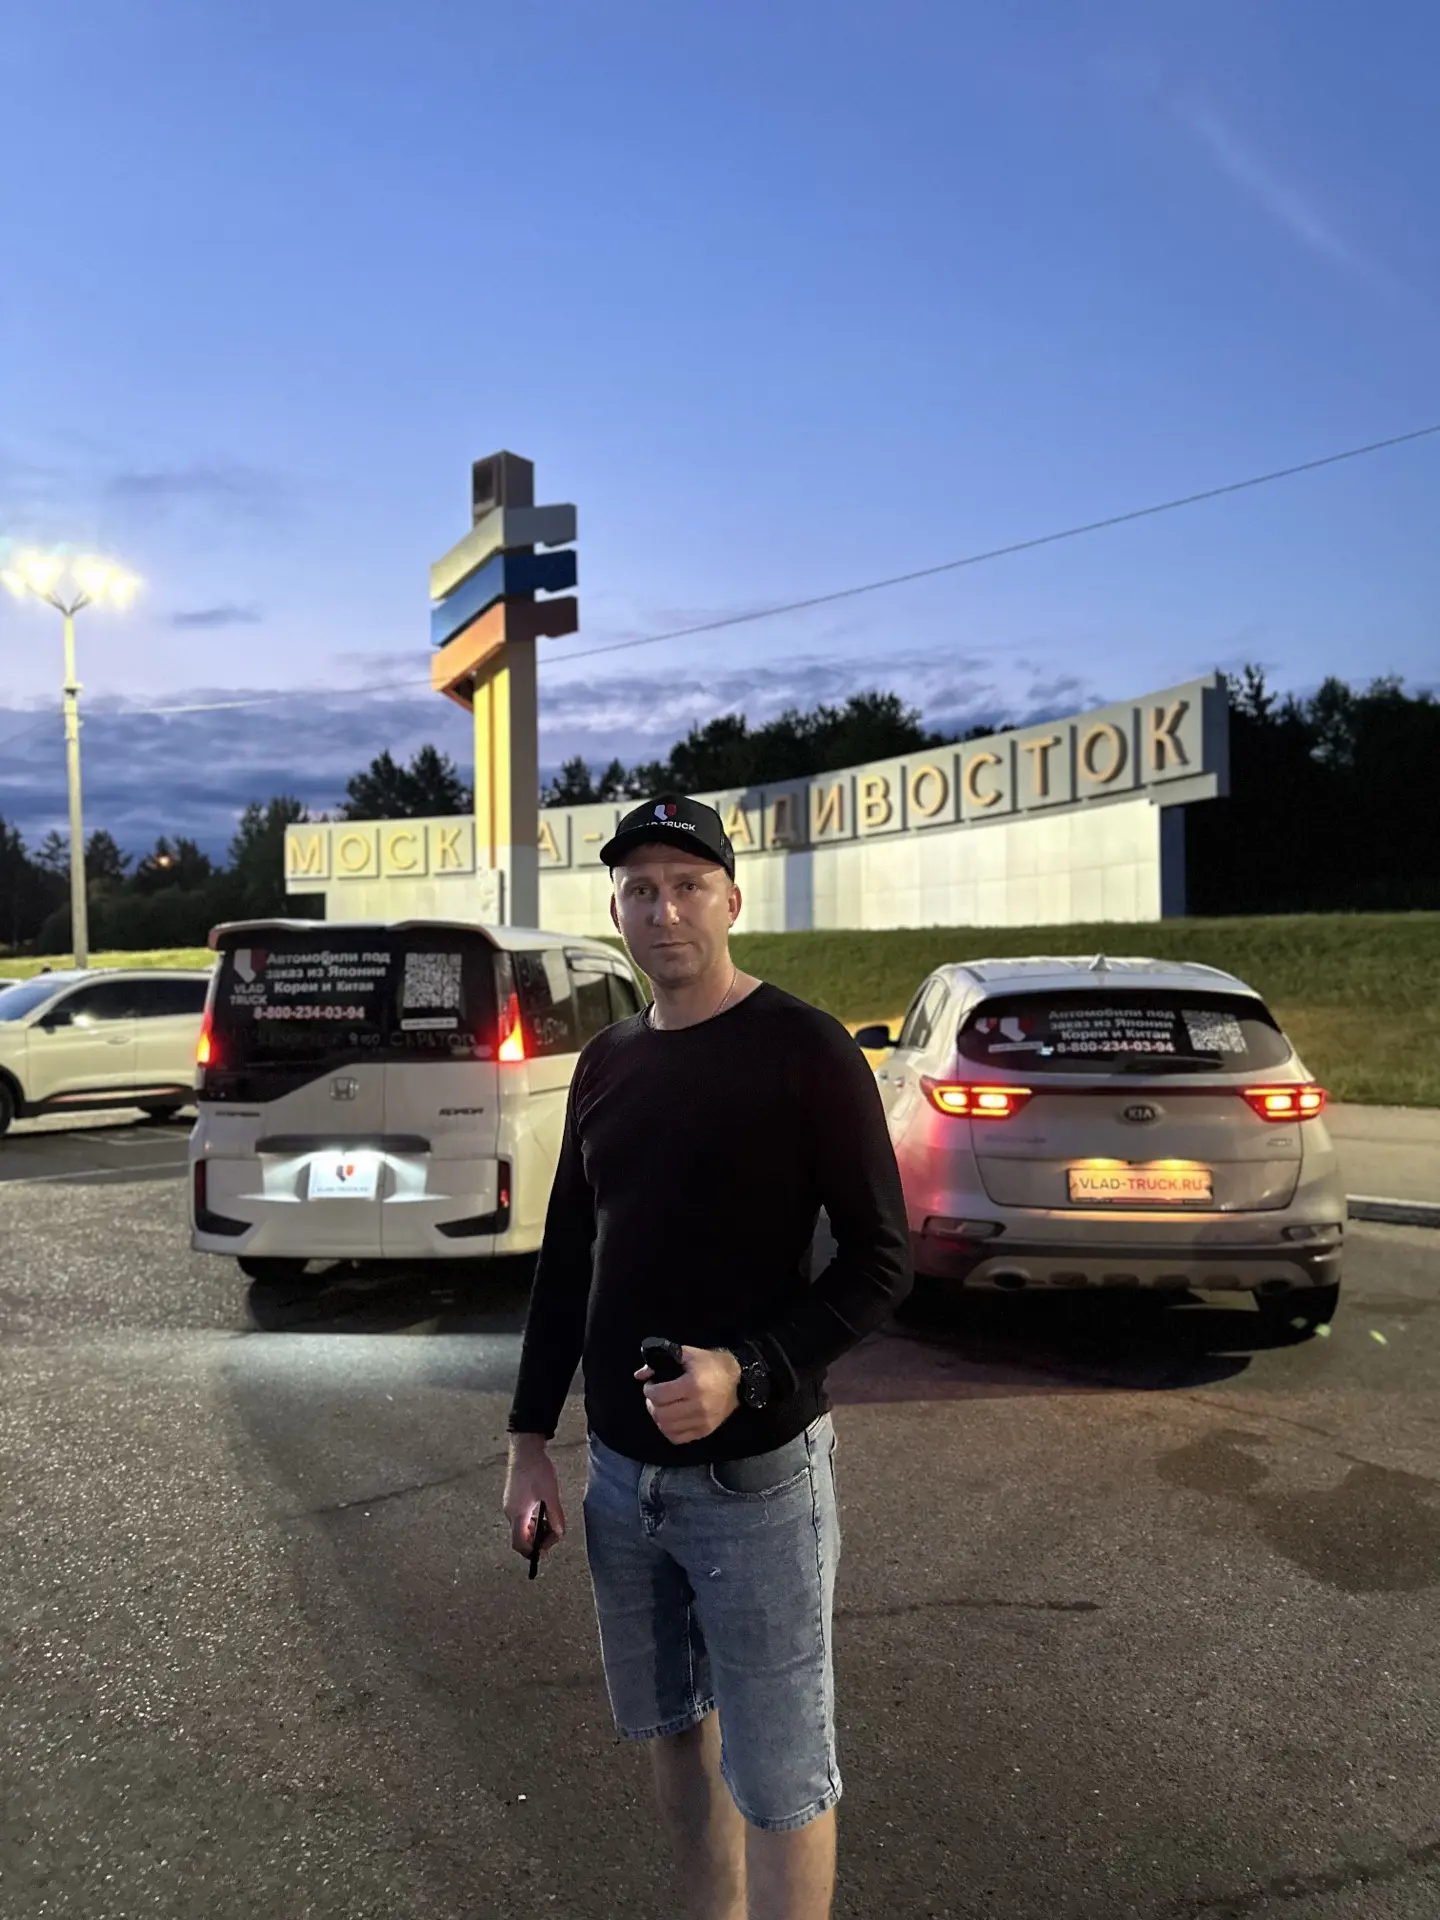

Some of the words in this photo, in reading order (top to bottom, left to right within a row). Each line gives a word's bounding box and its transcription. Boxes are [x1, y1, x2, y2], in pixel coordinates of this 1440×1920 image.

[266, 951, 358, 965] Автомобили
[361, 951, 391, 964] под
[265, 968, 304, 979] заказ
[307, 967, 324, 978] из
[327, 965, 387, 978] Японии
[234, 984, 266, 994] VLAD
[274, 981, 318, 995] Кореи
[321, 982, 332, 992] и
[336, 981, 374, 992] Китая
[230, 994, 268, 1006] TRUCK
[253, 1005, 365, 1020] 8-800-234-03-94
[1049, 1009, 1145, 1020] Автомобили
[1146, 1009, 1176, 1020] под
[1050, 1020, 1092, 1030] заказ
[1094, 1020, 1112, 1029] из
[1114, 1019, 1174, 1030] Японии
[1111, 1030, 1123, 1040] и
[1125, 1028, 1171, 1040] Китая
[1056, 1041, 1176, 1053] 8-800-234-03-94
[1130, 1107, 1153, 1119] KIA
[1079, 1177, 1204, 1191] VLAD-TRUCK.RU
